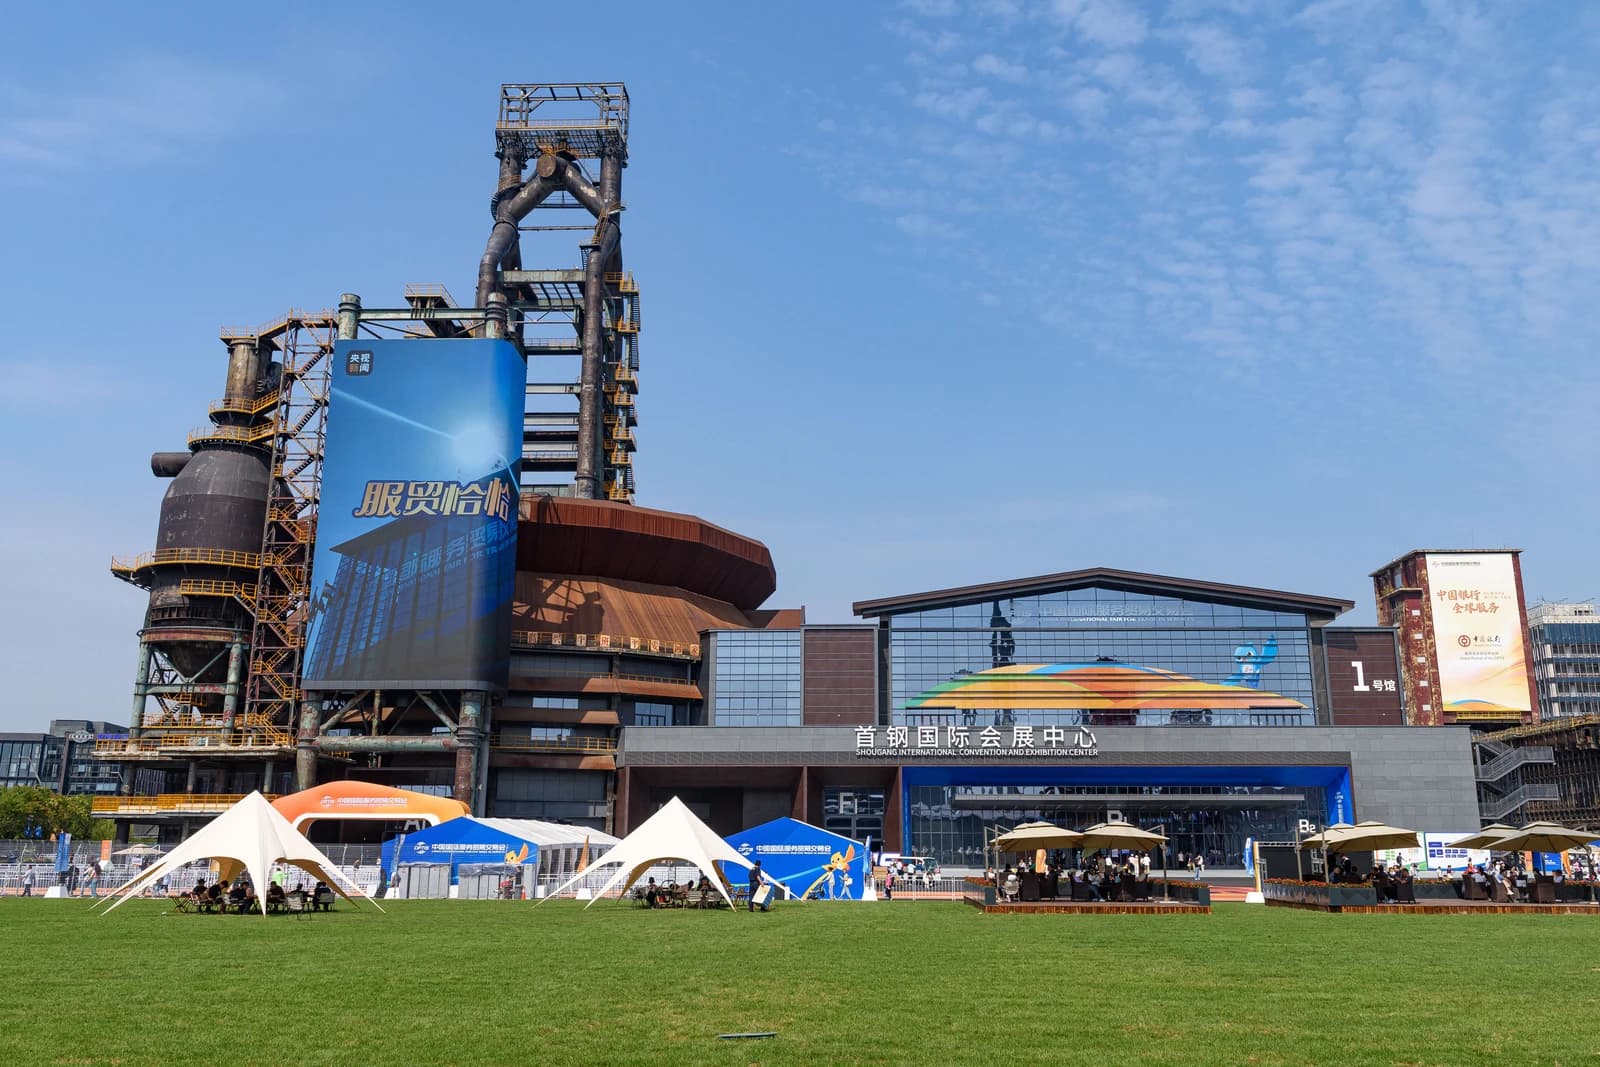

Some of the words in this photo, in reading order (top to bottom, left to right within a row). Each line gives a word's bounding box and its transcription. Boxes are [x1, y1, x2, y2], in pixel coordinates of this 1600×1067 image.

[350, 350, 370, 362] 央视
[354, 478, 511, 521] 服贸恰恰
[1351, 661, 1370, 692] 1
[1372, 679, 1396, 692] 号馆
[854, 726, 1097, 749] 首钢国际会展中心
[1298, 819, 1316, 833] B2
